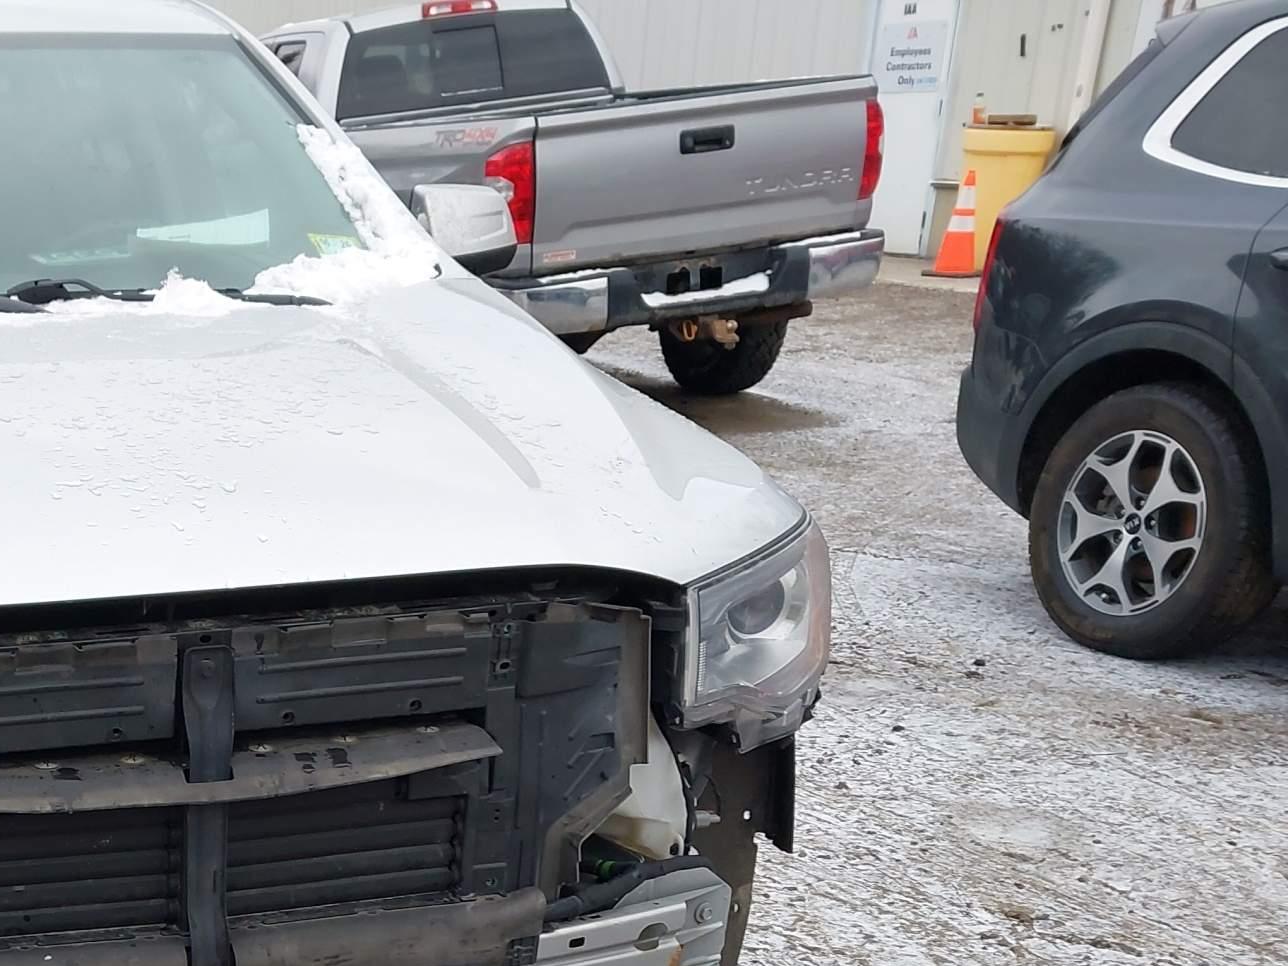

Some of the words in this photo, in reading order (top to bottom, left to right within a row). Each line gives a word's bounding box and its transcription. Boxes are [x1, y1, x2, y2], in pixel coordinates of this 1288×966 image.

[890, 47, 932, 58] Employees
[886, 62, 932, 71] Contractors
[897, 75, 914, 87] Only
